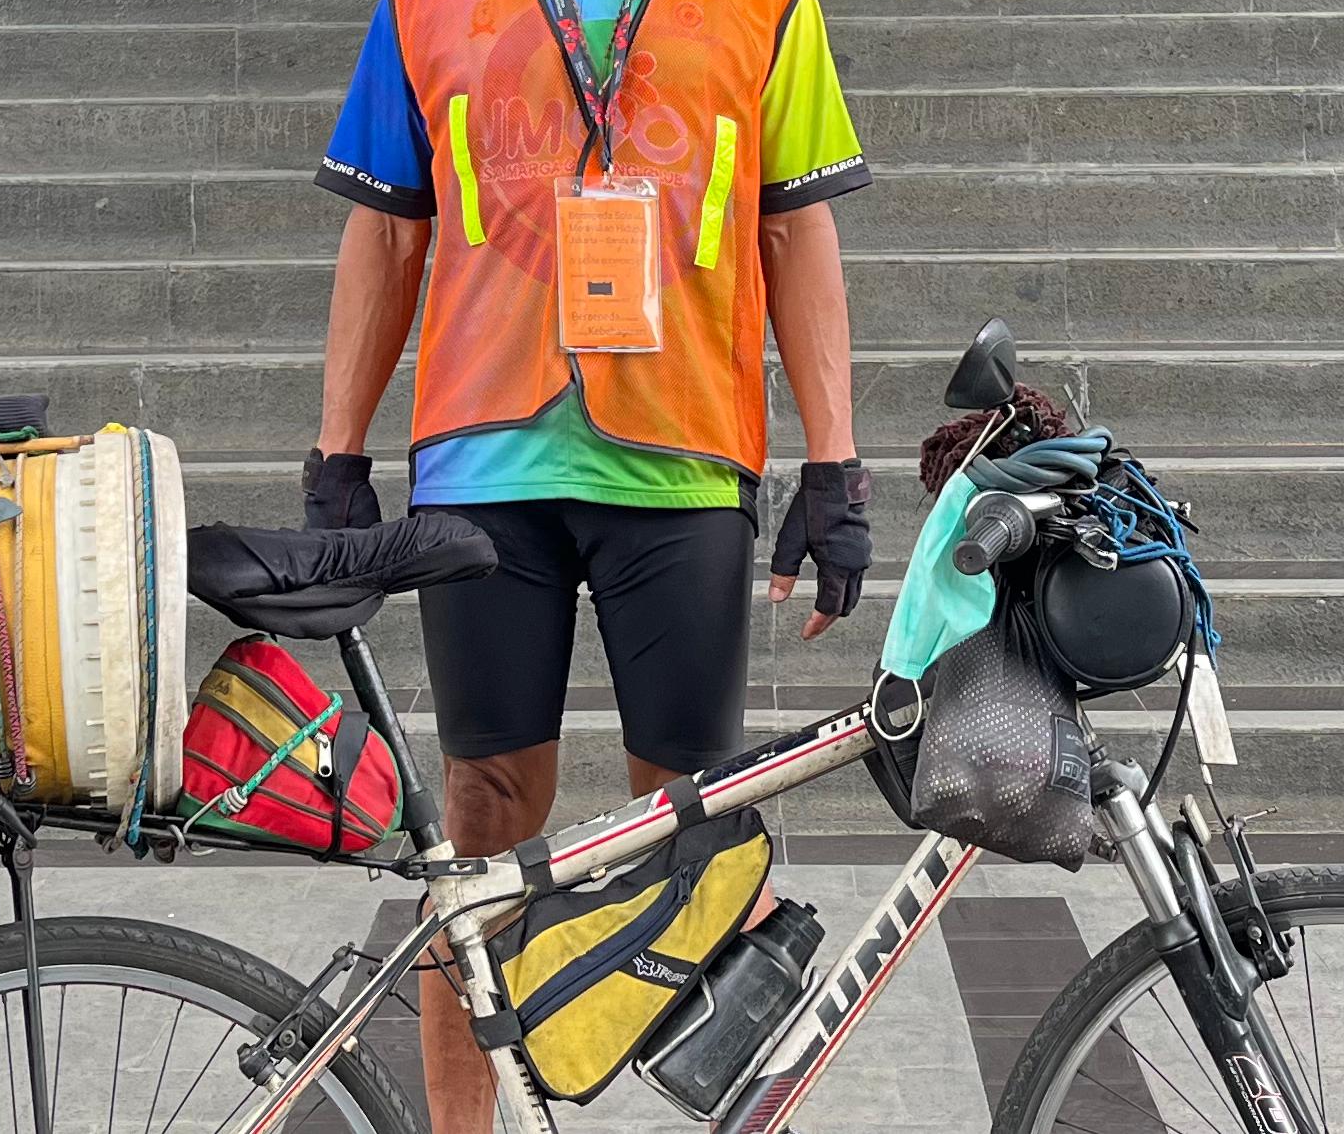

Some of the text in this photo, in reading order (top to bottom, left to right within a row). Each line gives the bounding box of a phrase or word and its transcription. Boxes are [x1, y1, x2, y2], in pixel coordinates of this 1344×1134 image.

[356, 172, 392, 193] CLUB
[783, 155, 864, 191] JASA MARGA
